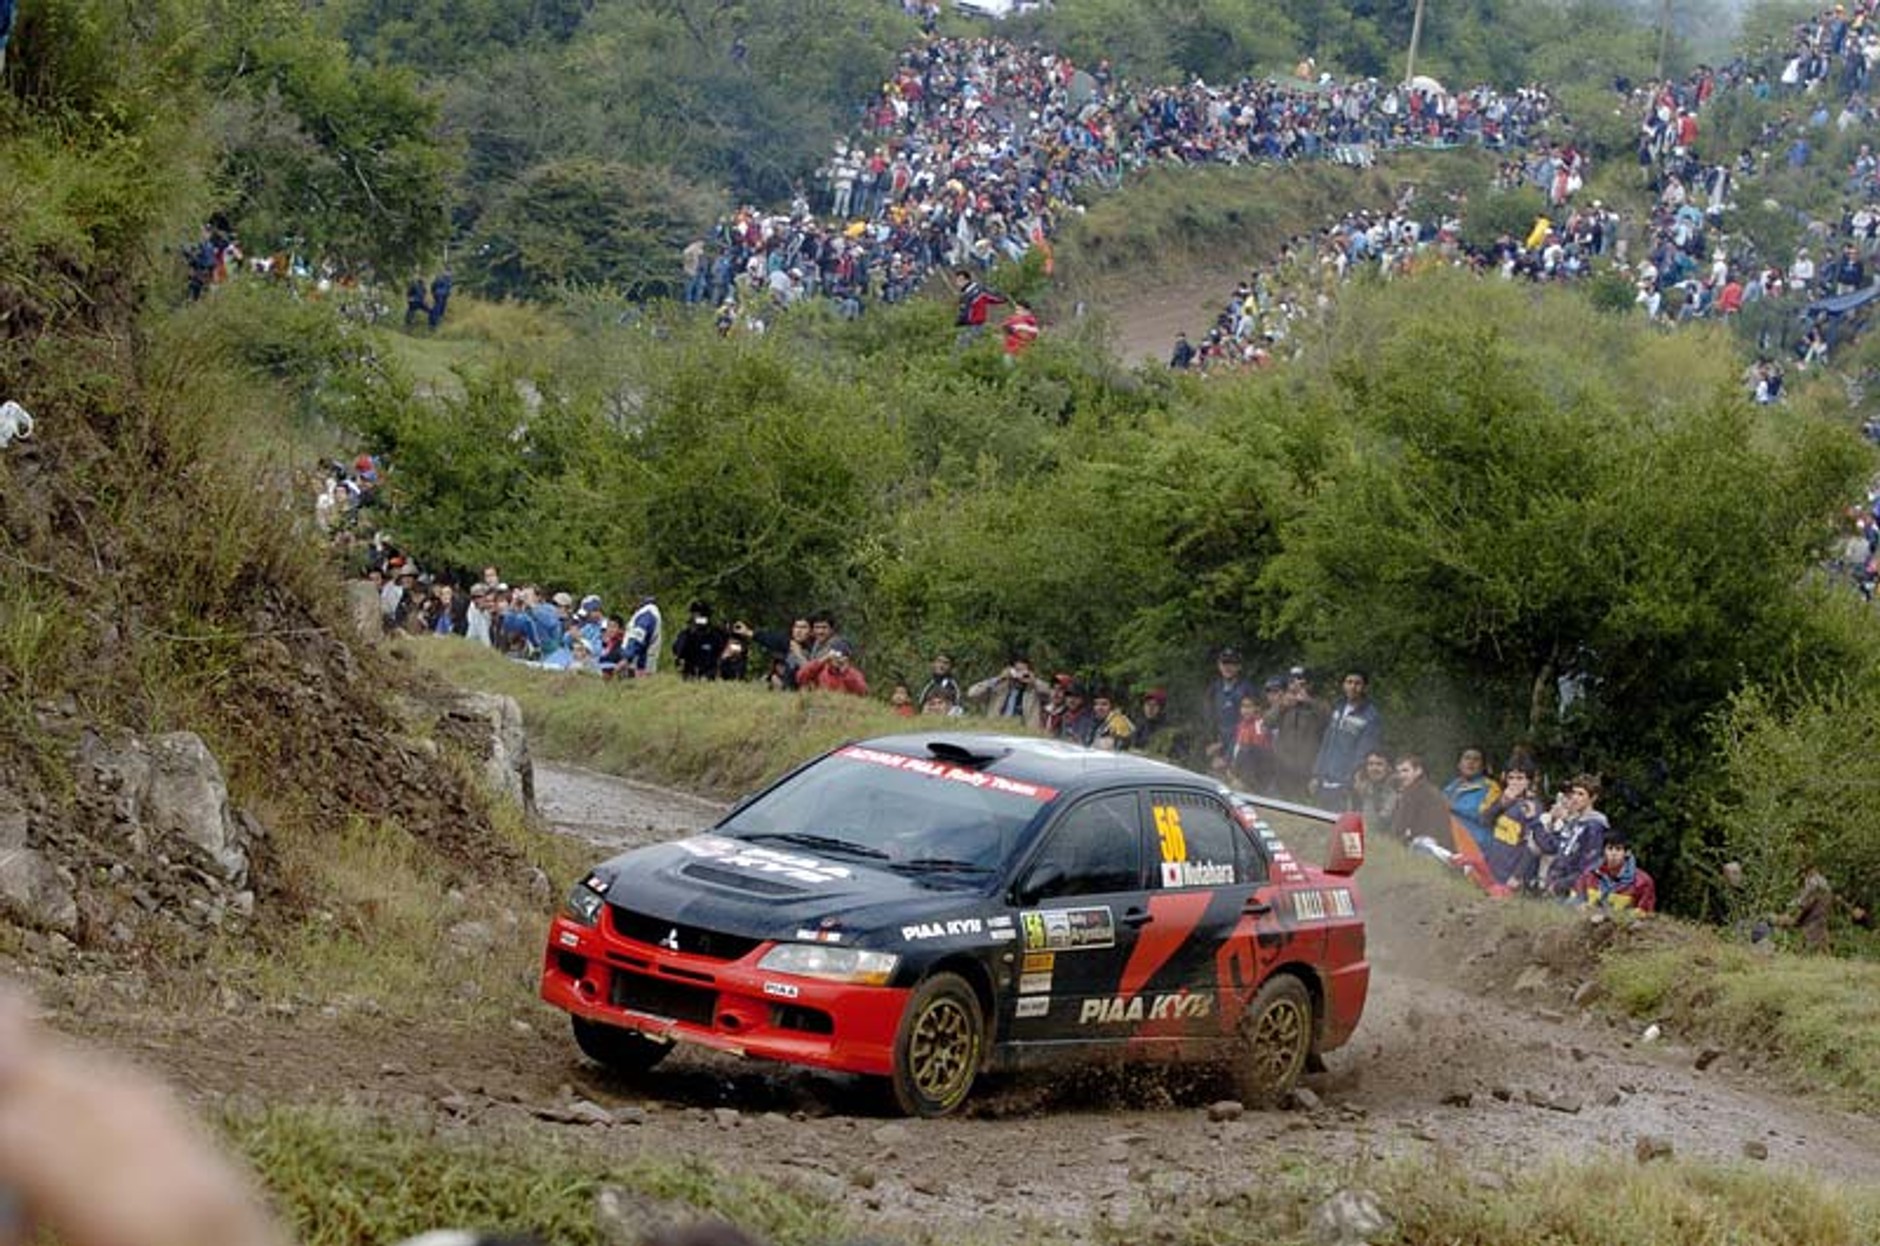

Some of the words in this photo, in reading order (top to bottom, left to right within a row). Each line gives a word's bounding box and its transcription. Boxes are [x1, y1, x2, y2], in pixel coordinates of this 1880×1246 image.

[1153, 805, 1186, 862] 56
[902, 922, 946, 942] PIAA
[1079, 996, 1144, 1025] PIAA
